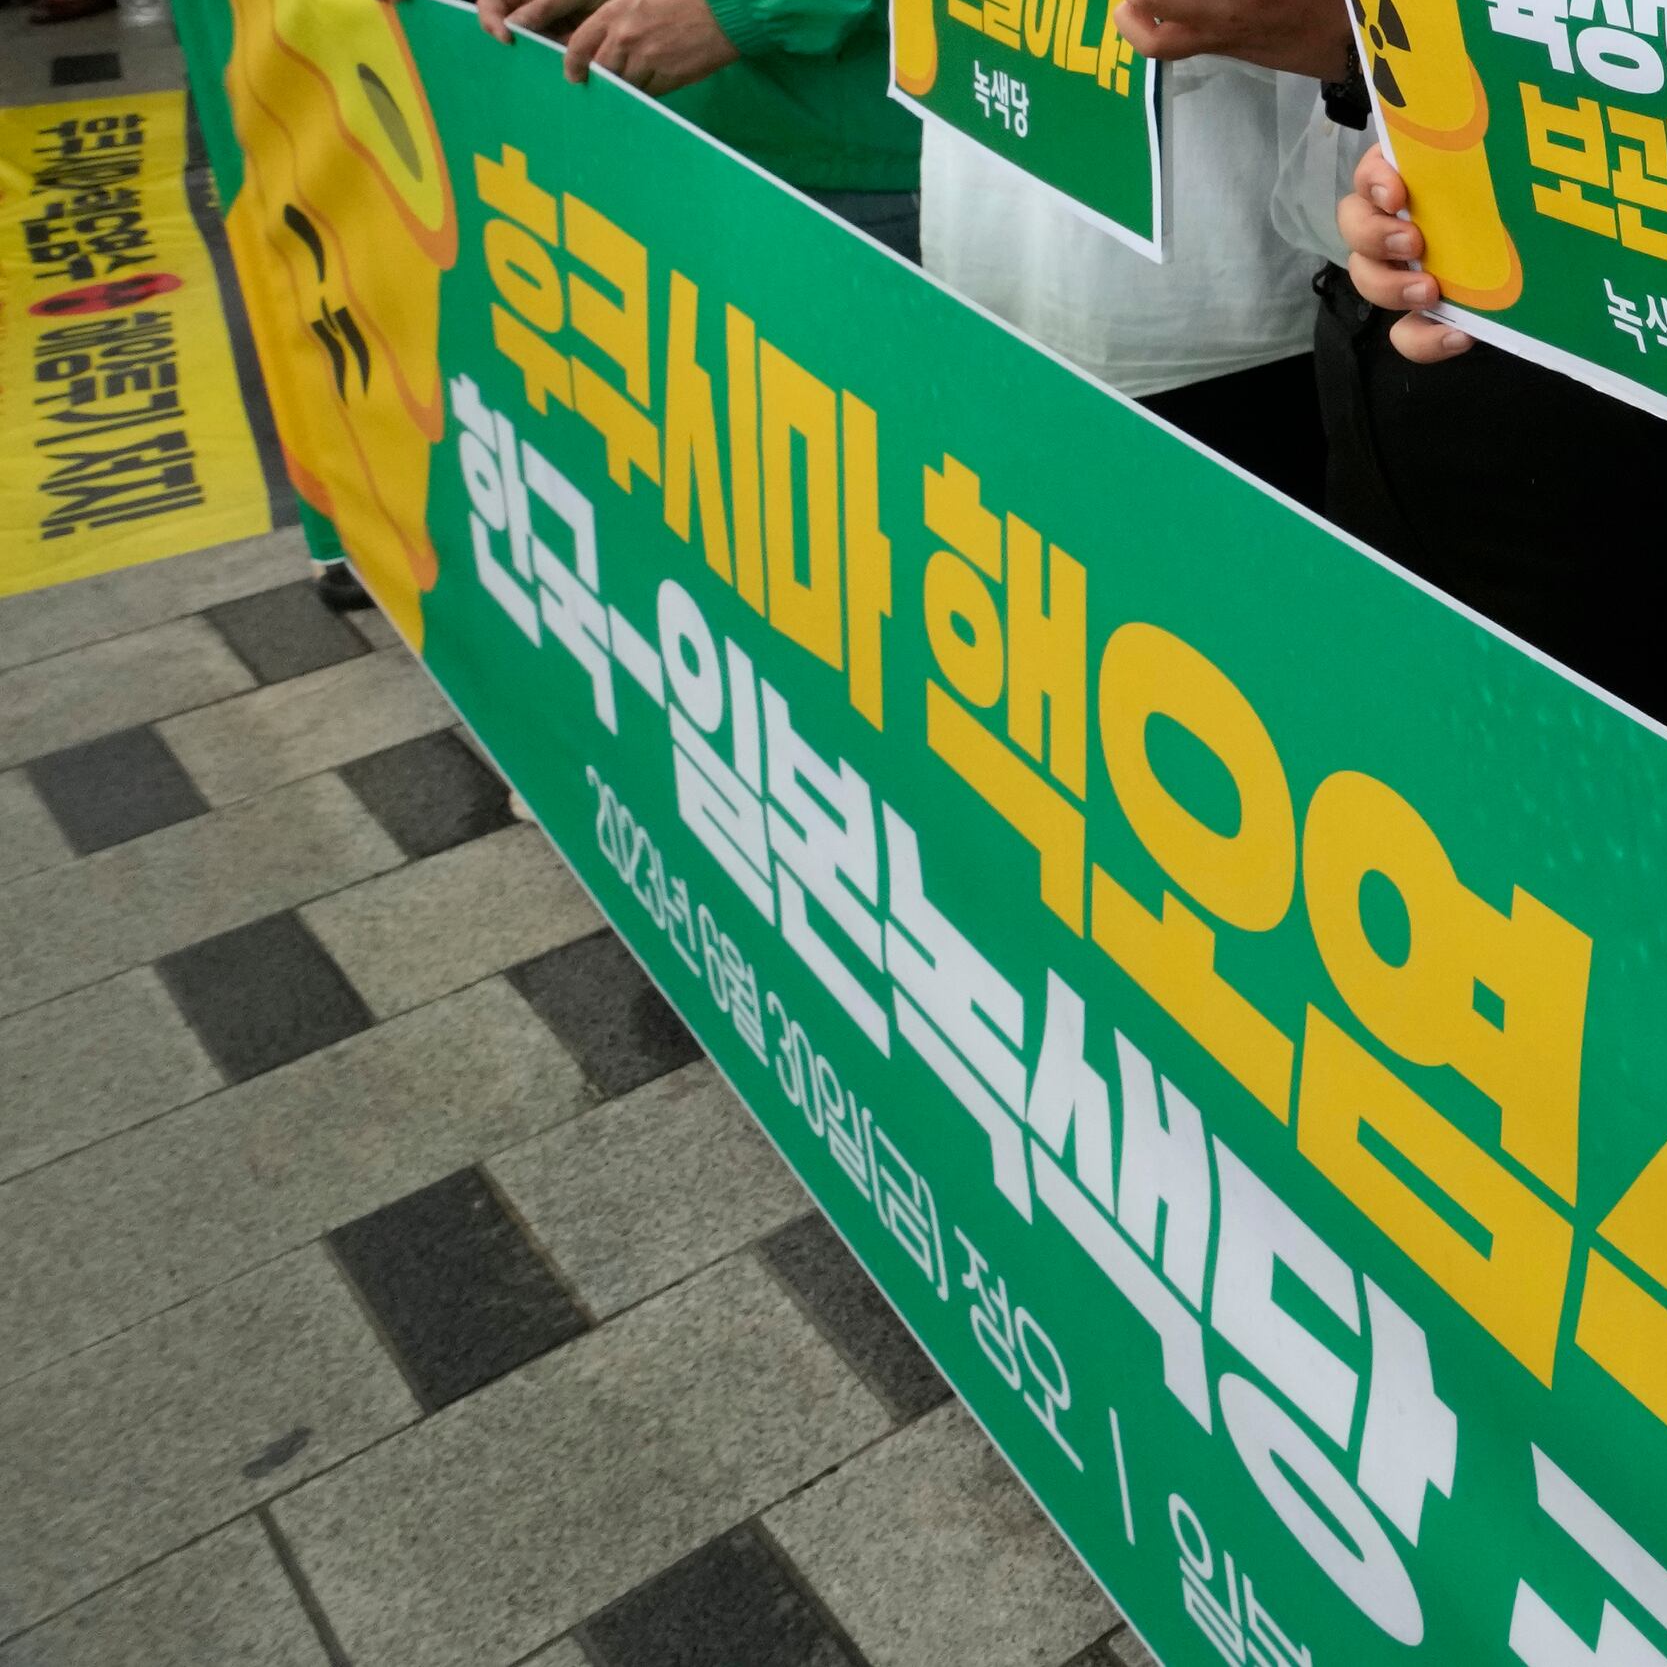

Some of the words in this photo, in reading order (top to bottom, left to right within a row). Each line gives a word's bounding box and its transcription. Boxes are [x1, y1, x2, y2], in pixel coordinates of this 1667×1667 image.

[973, 59, 1030, 138] 녹색당
[474, 143, 893, 733] 후쿠시마
[585, 765, 700, 977] 2023년
[698, 904, 769, 1067] 6월
[766, 991, 949, 1302] 30일(금)
[954, 1225, 1084, 1472] 정오
